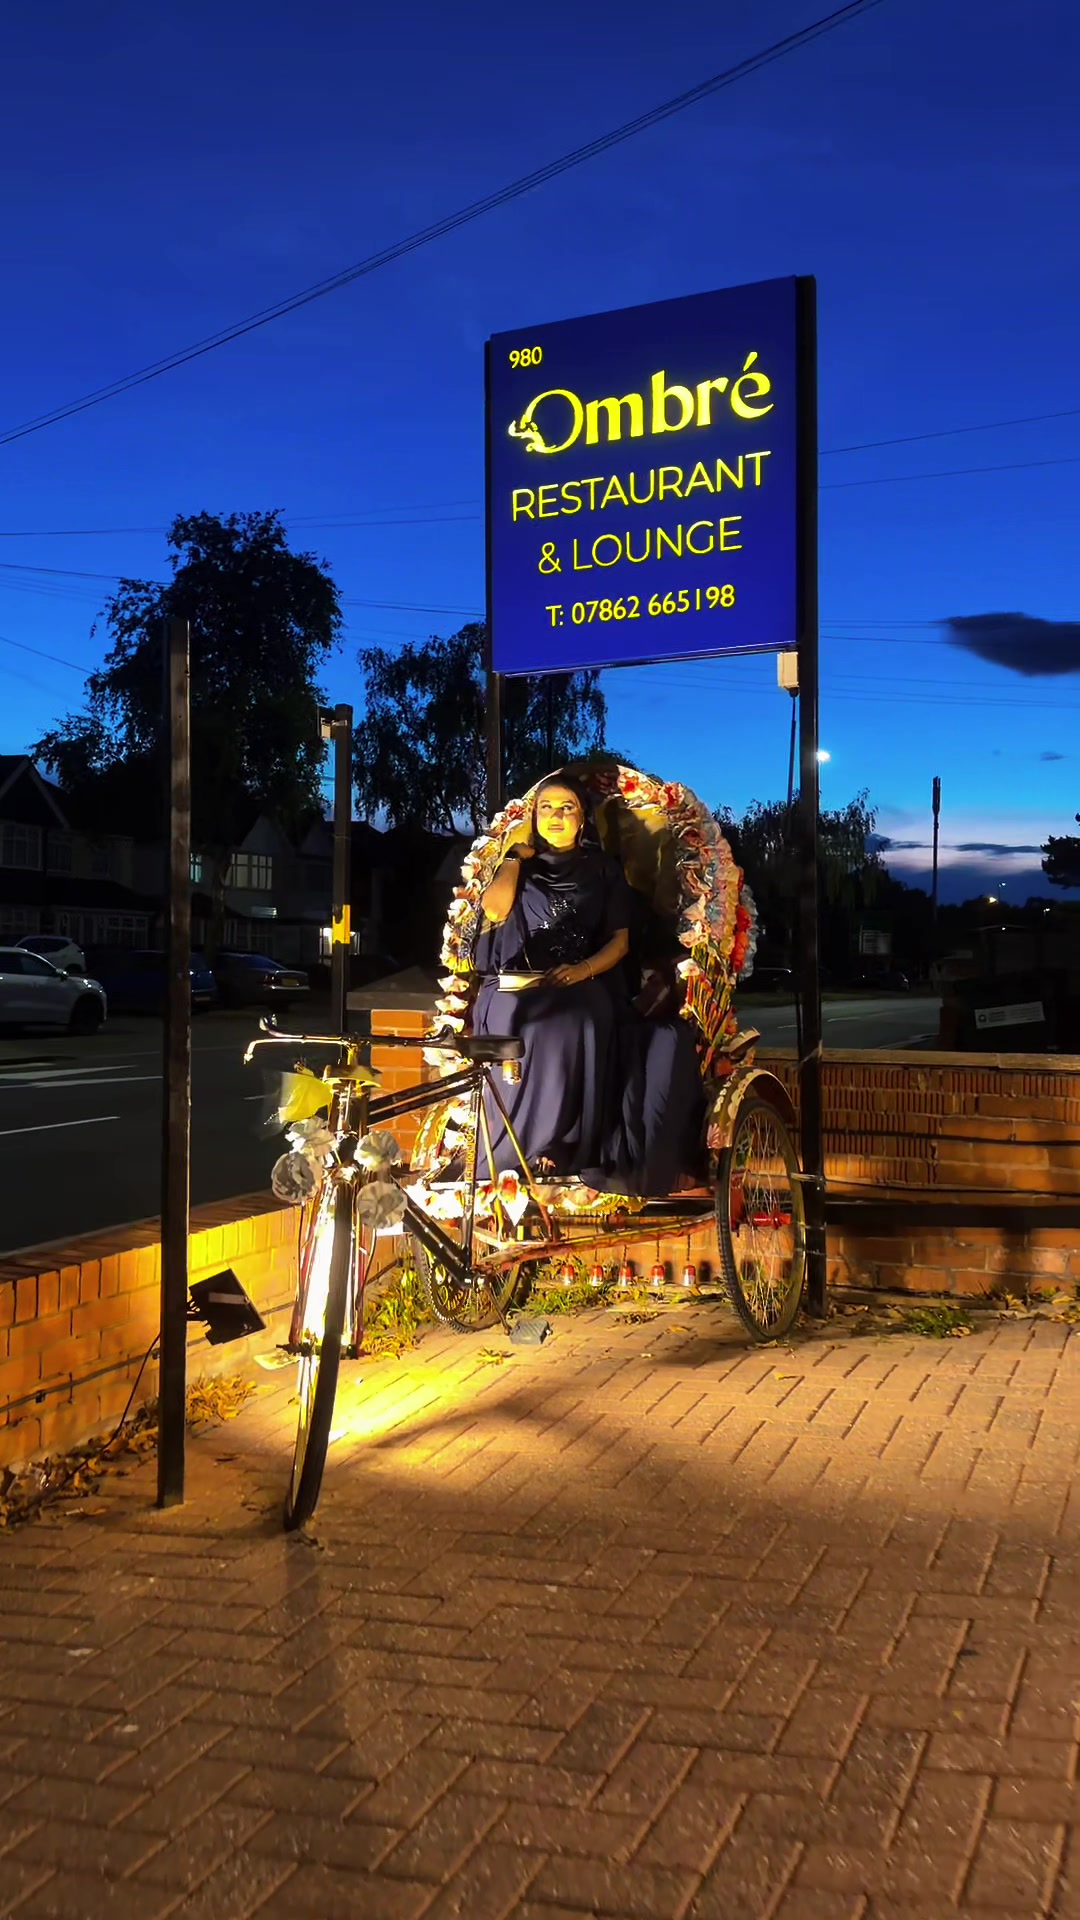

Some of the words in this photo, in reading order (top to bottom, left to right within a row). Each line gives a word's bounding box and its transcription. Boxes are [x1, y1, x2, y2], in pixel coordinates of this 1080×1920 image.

[508, 346, 543, 369] 980
[508, 351, 774, 454] Ombré
[512, 450, 772, 522] RESTAURANT
[538, 542, 562, 574] &
[572, 515, 743, 571] LOUNGE
[545, 604, 564, 627] T:
[571, 595, 641, 625] 07862
[647, 584, 736, 616] 665198
